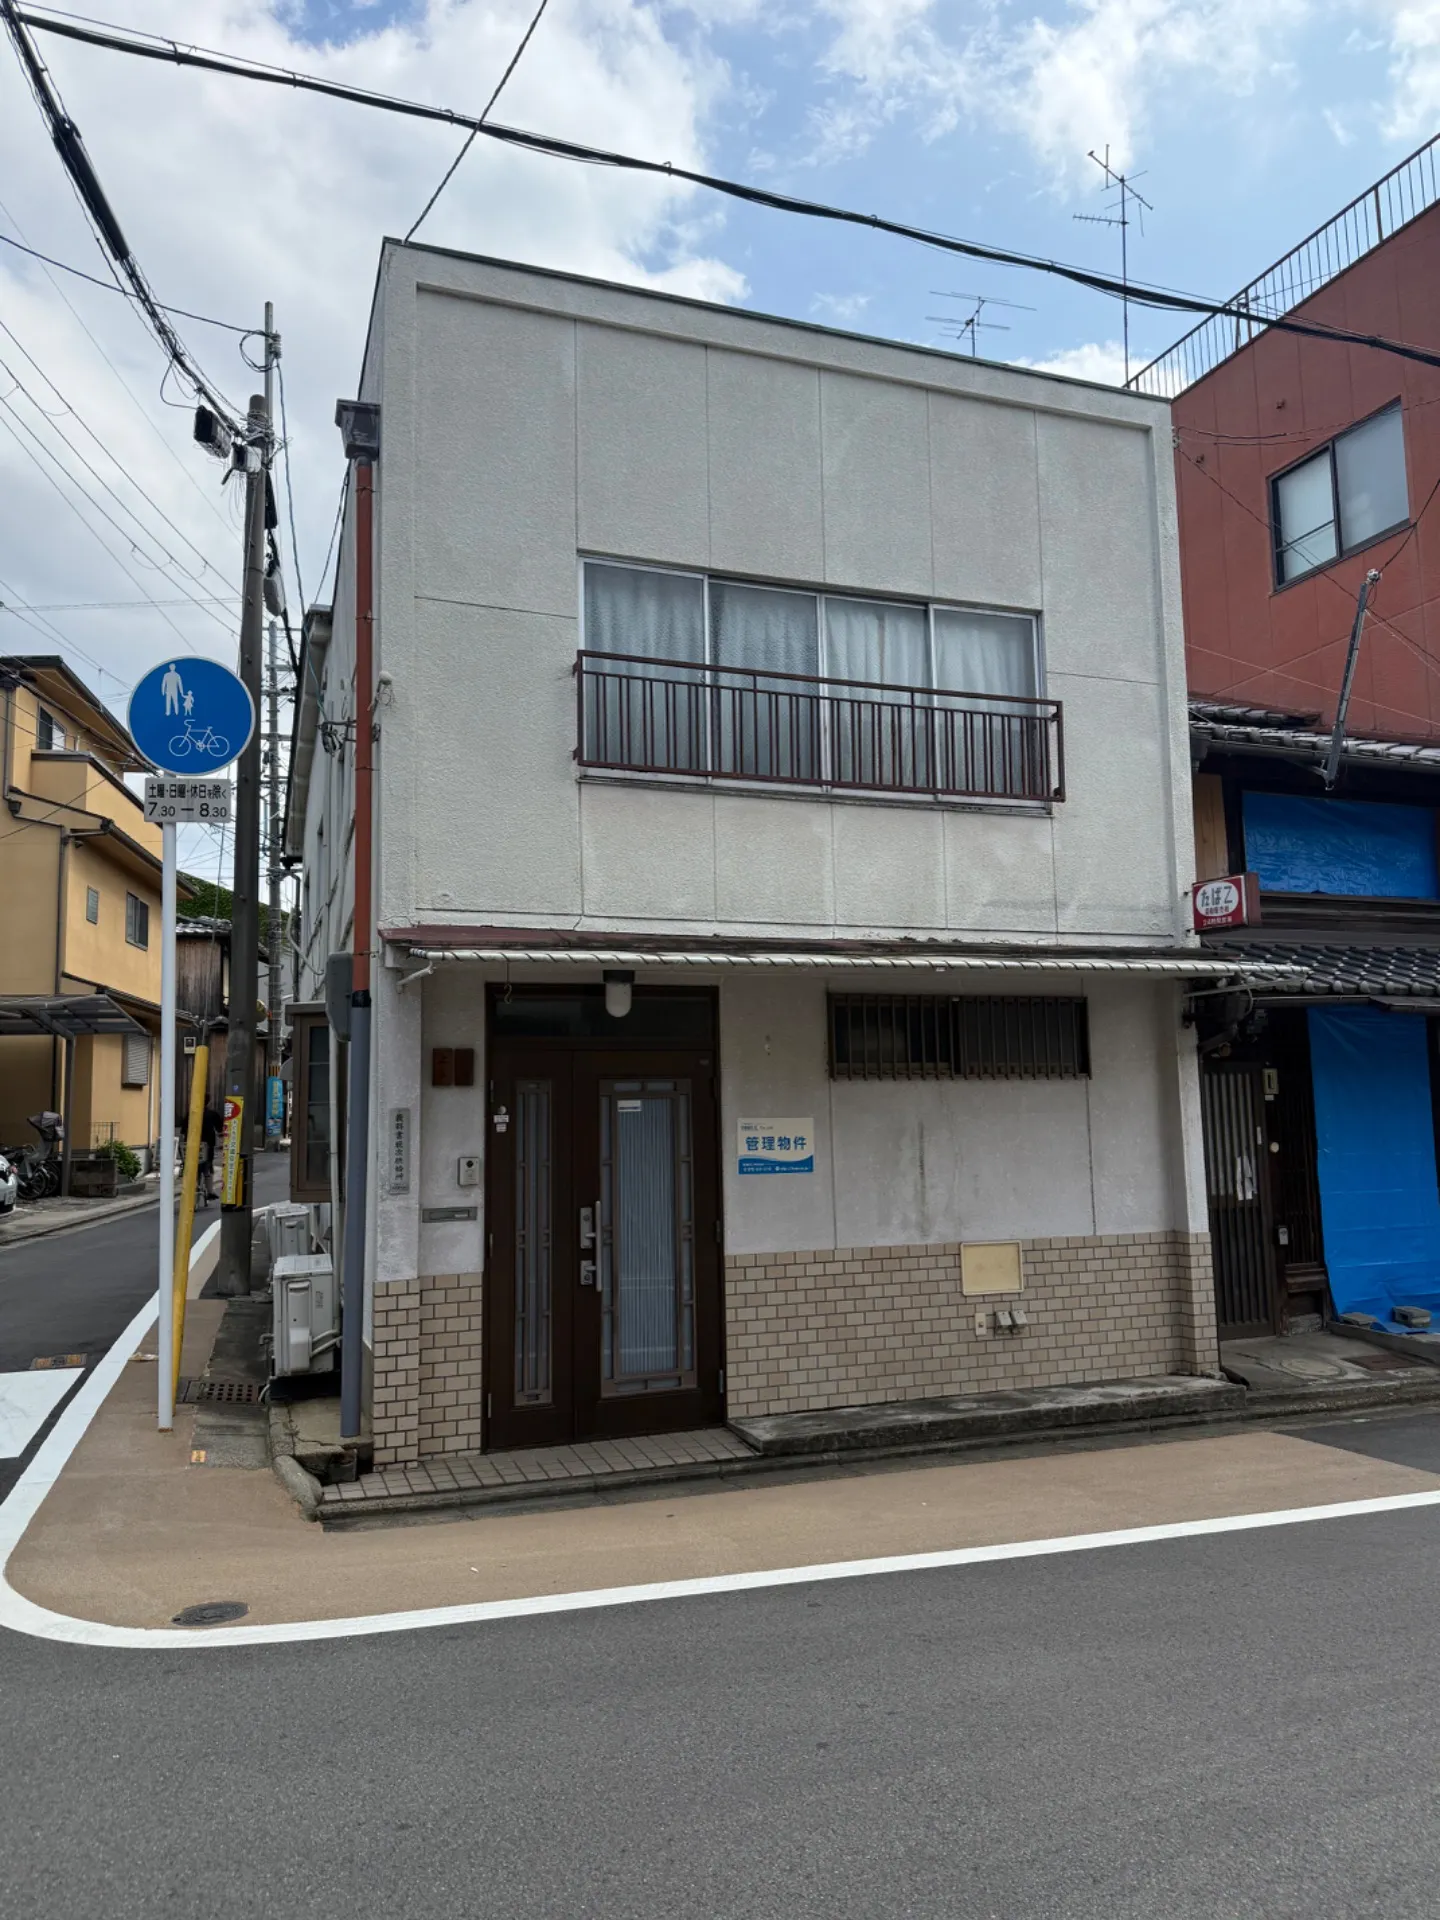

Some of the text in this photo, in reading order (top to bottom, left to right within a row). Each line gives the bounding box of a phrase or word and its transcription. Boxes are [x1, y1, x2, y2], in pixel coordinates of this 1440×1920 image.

[1201, 885, 1233, 908] たばこ
[745, 1135, 807, 1152] 管理物件
